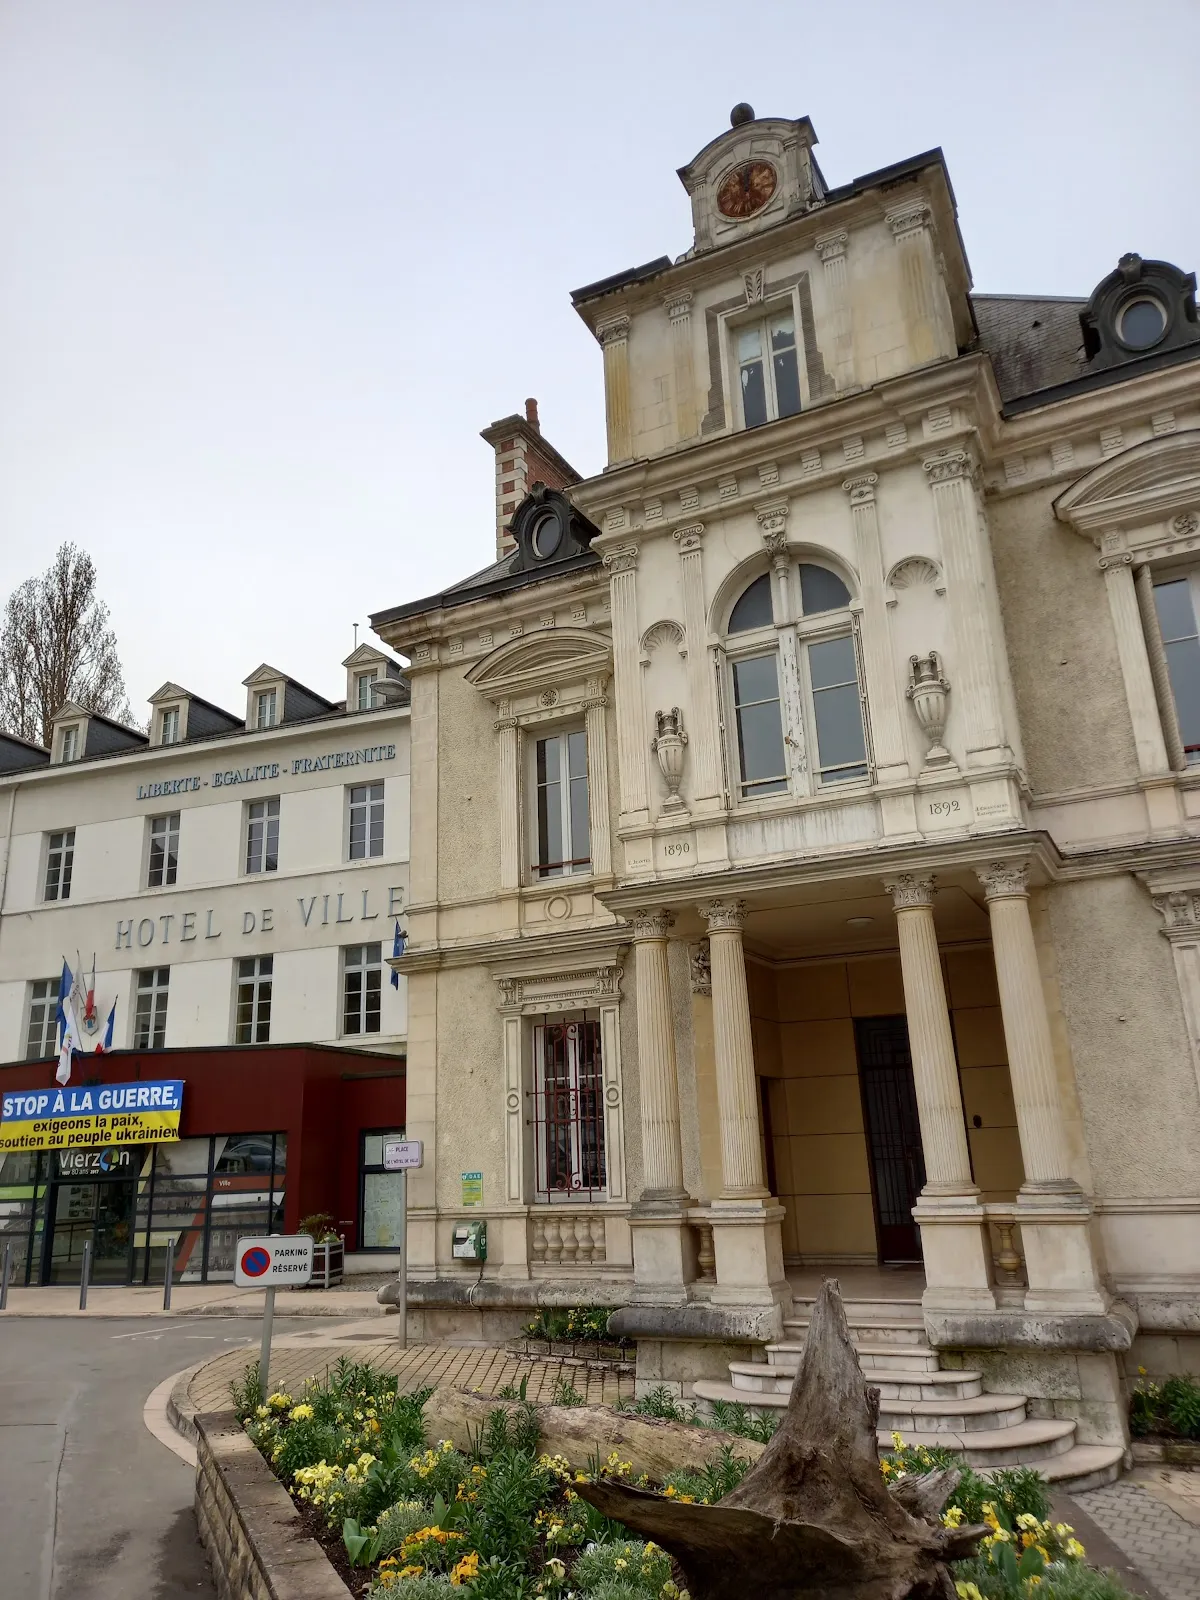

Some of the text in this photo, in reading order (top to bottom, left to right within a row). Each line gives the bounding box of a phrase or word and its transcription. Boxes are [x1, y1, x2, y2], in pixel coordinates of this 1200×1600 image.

[136, 776, 200, 800] LIBERTE
[212, 763, 279, 788] EGALITE
[291, 744, 396, 775] FRATERNITE
[929, 800, 961, 817] 1892
[664, 842, 690, 856] 1890
[115, 886, 405, 949] HOTEL DE VILLE
[3, 1085, 178, 1117] STOP À LA GUERRE,
[33, 1113, 143, 1133] exigeons la paix,
[0, 1126, 180, 1148] soutien au peuple ukrainien
[274, 1248, 308, 1257] PARKING
[272, 1262, 308, 1273] RÉSERVÉ
